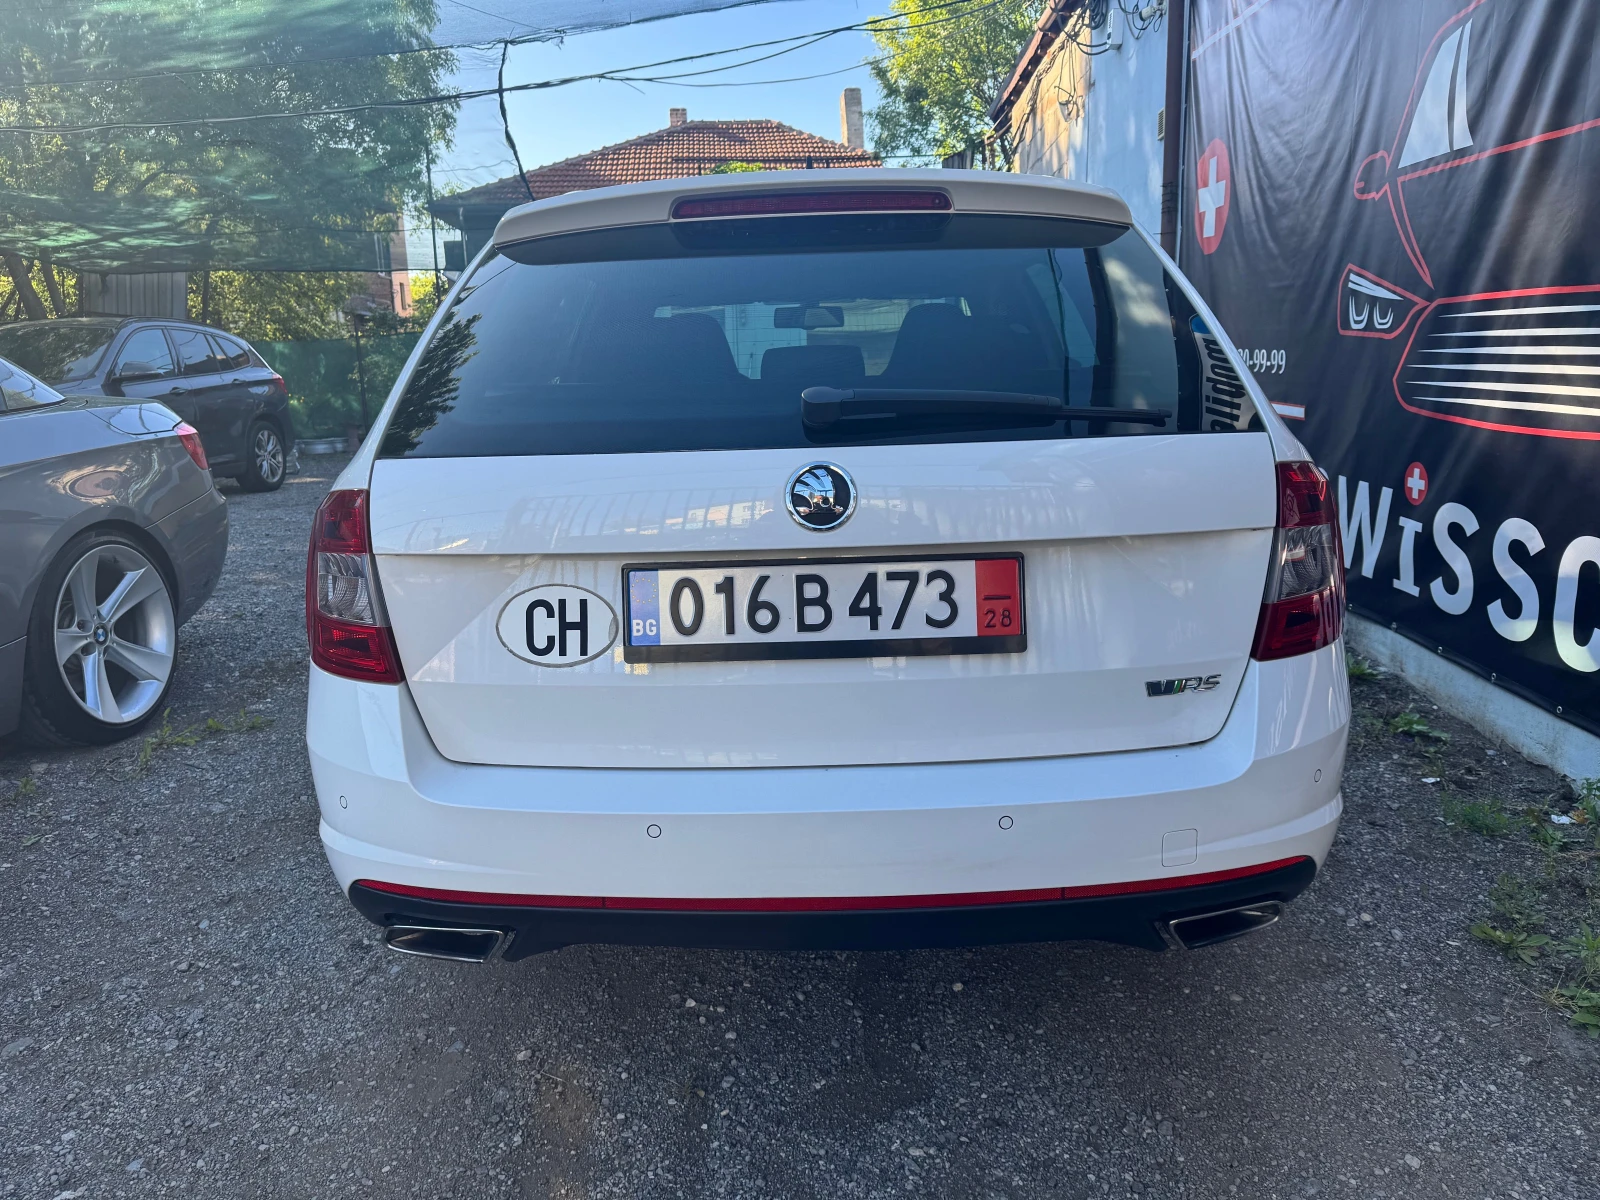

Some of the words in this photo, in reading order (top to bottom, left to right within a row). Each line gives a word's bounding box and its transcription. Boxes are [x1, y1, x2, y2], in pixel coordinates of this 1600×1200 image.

[525, 598, 588, 656] CH
[632, 618, 657, 637] BG
[984, 608, 1012, 628] 28
